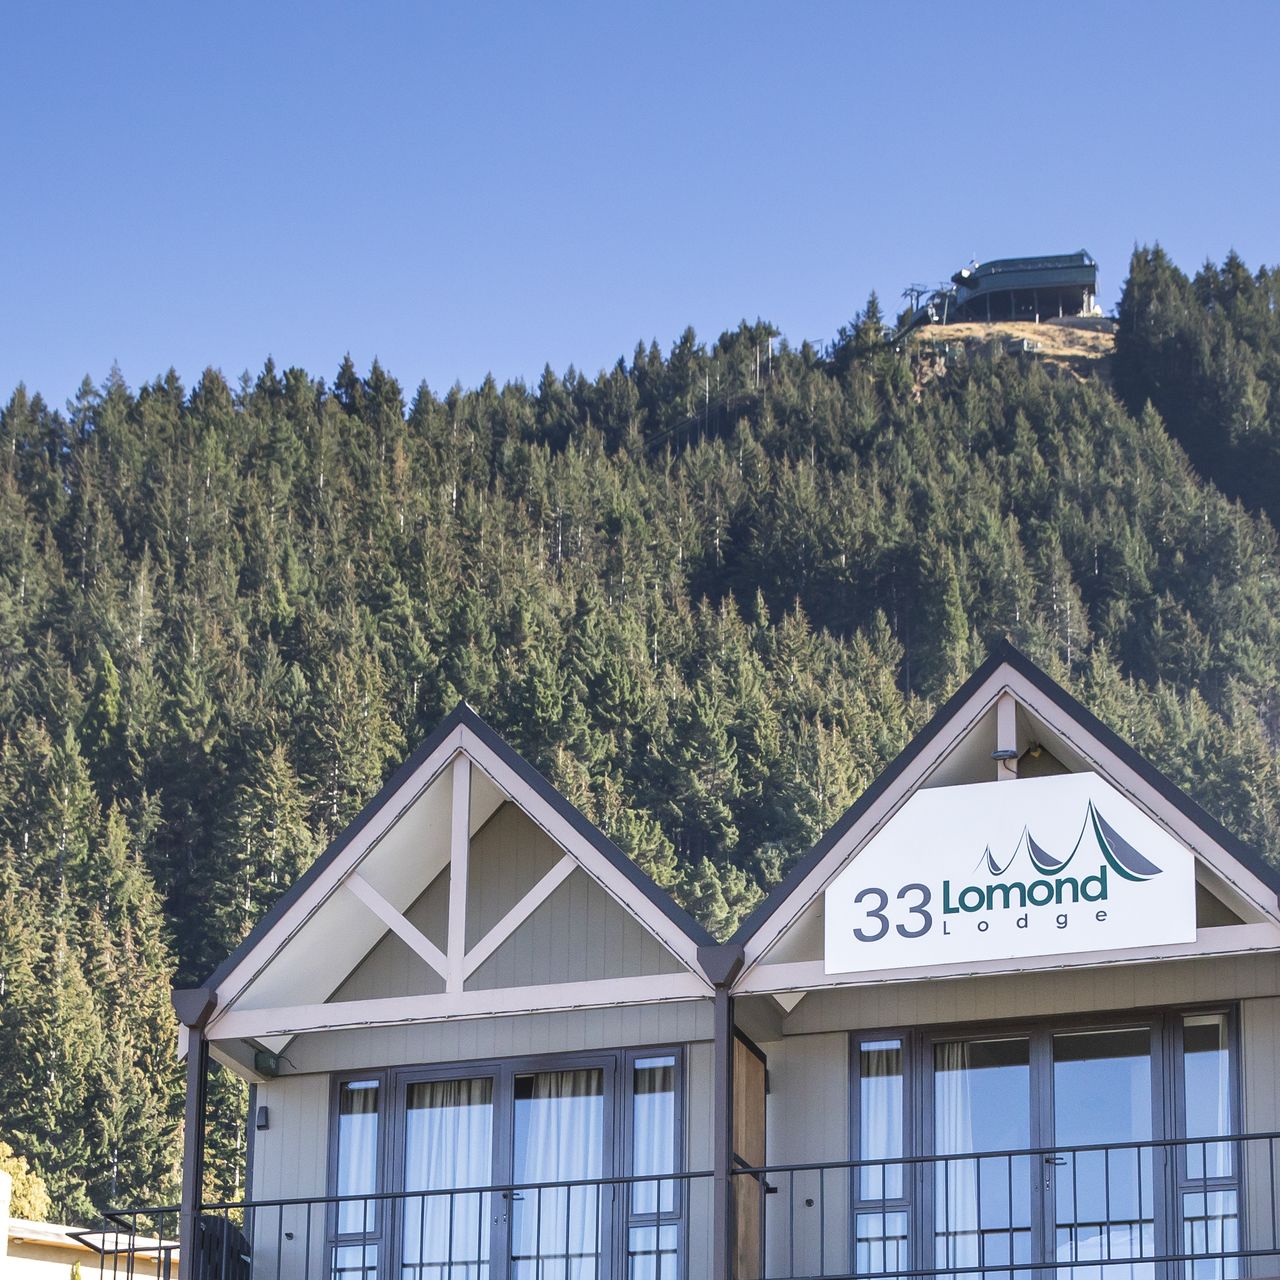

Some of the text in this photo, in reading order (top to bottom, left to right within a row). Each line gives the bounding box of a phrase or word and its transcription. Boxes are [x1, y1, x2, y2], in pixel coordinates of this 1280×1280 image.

[852, 864, 1109, 943] 33 Lomond
[943, 907, 1108, 936] Lodge
